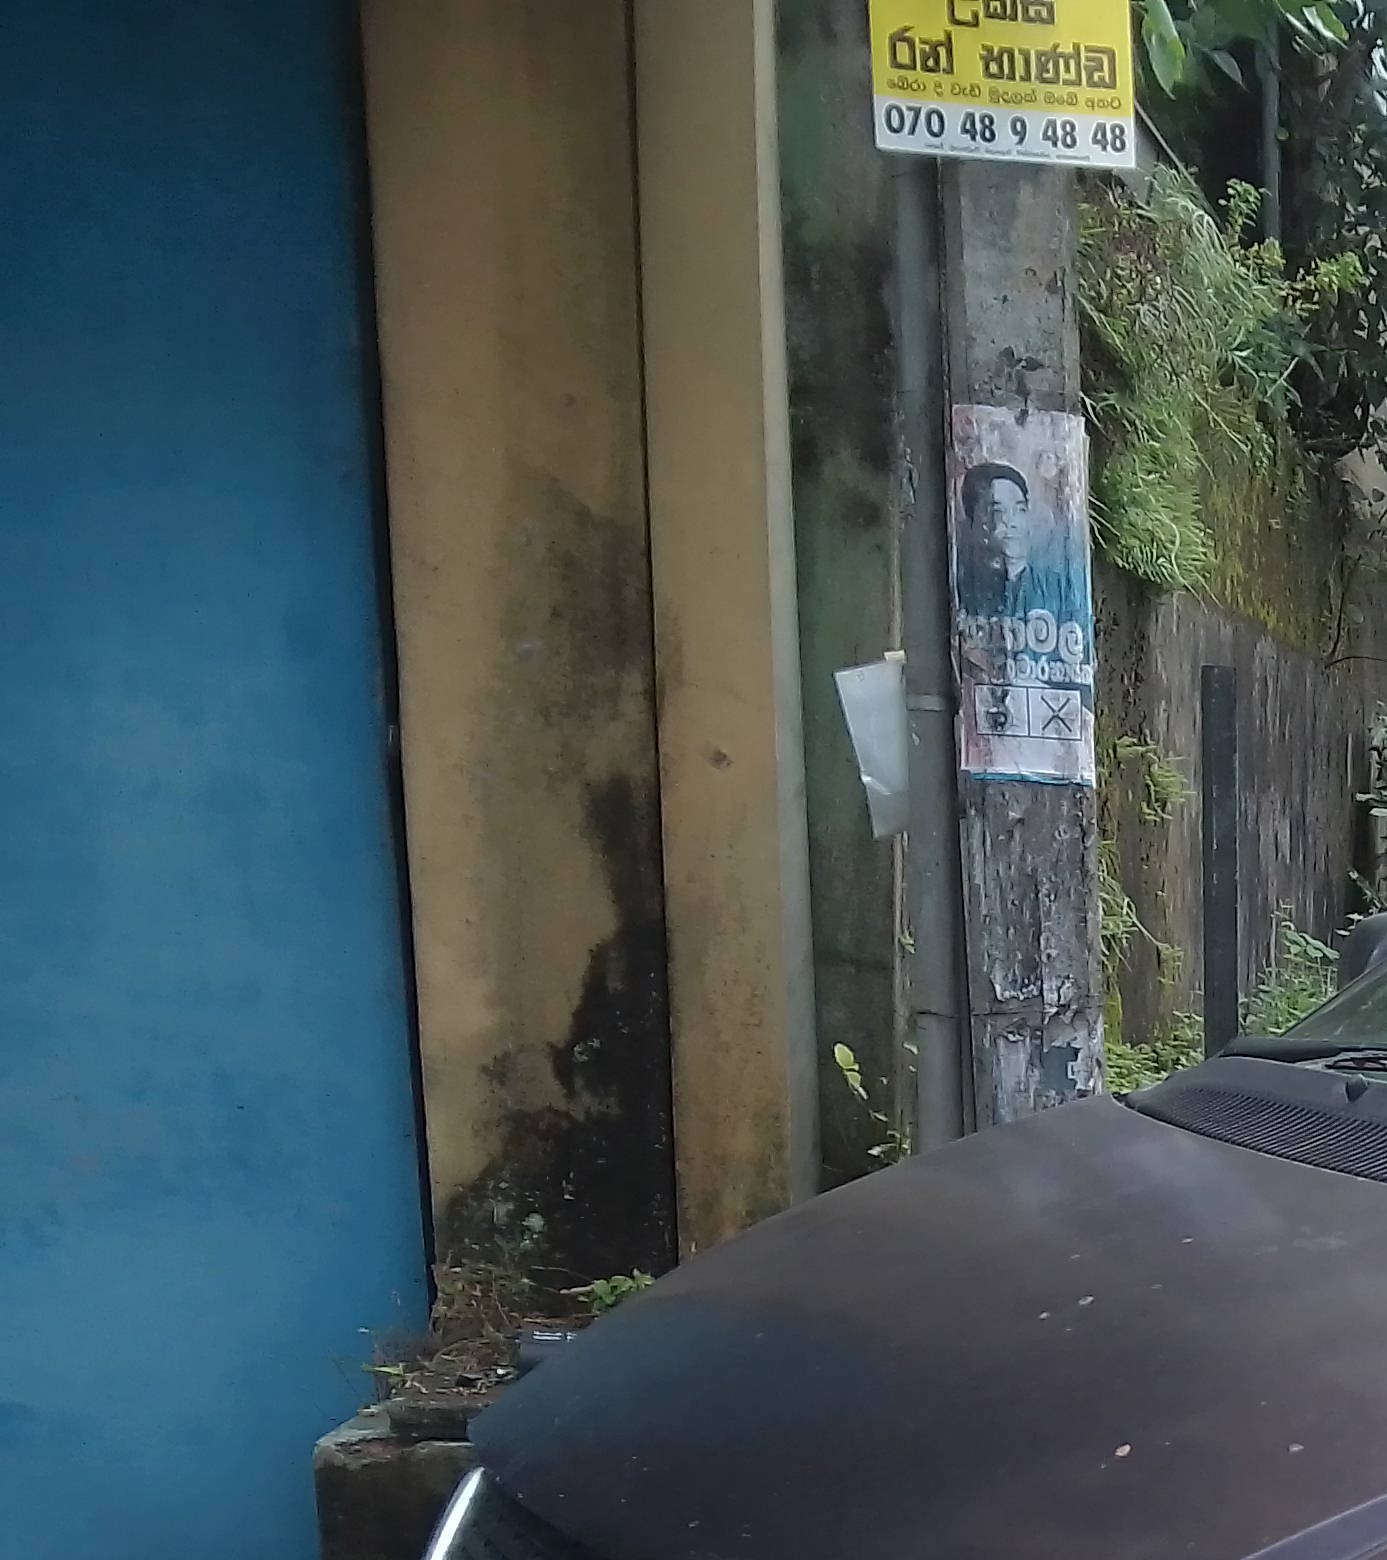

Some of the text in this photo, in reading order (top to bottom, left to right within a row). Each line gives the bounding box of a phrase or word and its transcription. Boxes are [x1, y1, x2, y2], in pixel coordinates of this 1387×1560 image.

[888, 25, 1117, 89] රන් භාණ්ඩ
[883, 102, 946, 138] 070
[959, 111, 996, 144] 48
[1010, 115, 1028, 146] 9
[1041, 118, 1078, 149] 48
[1091, 122, 1127, 153] 48
